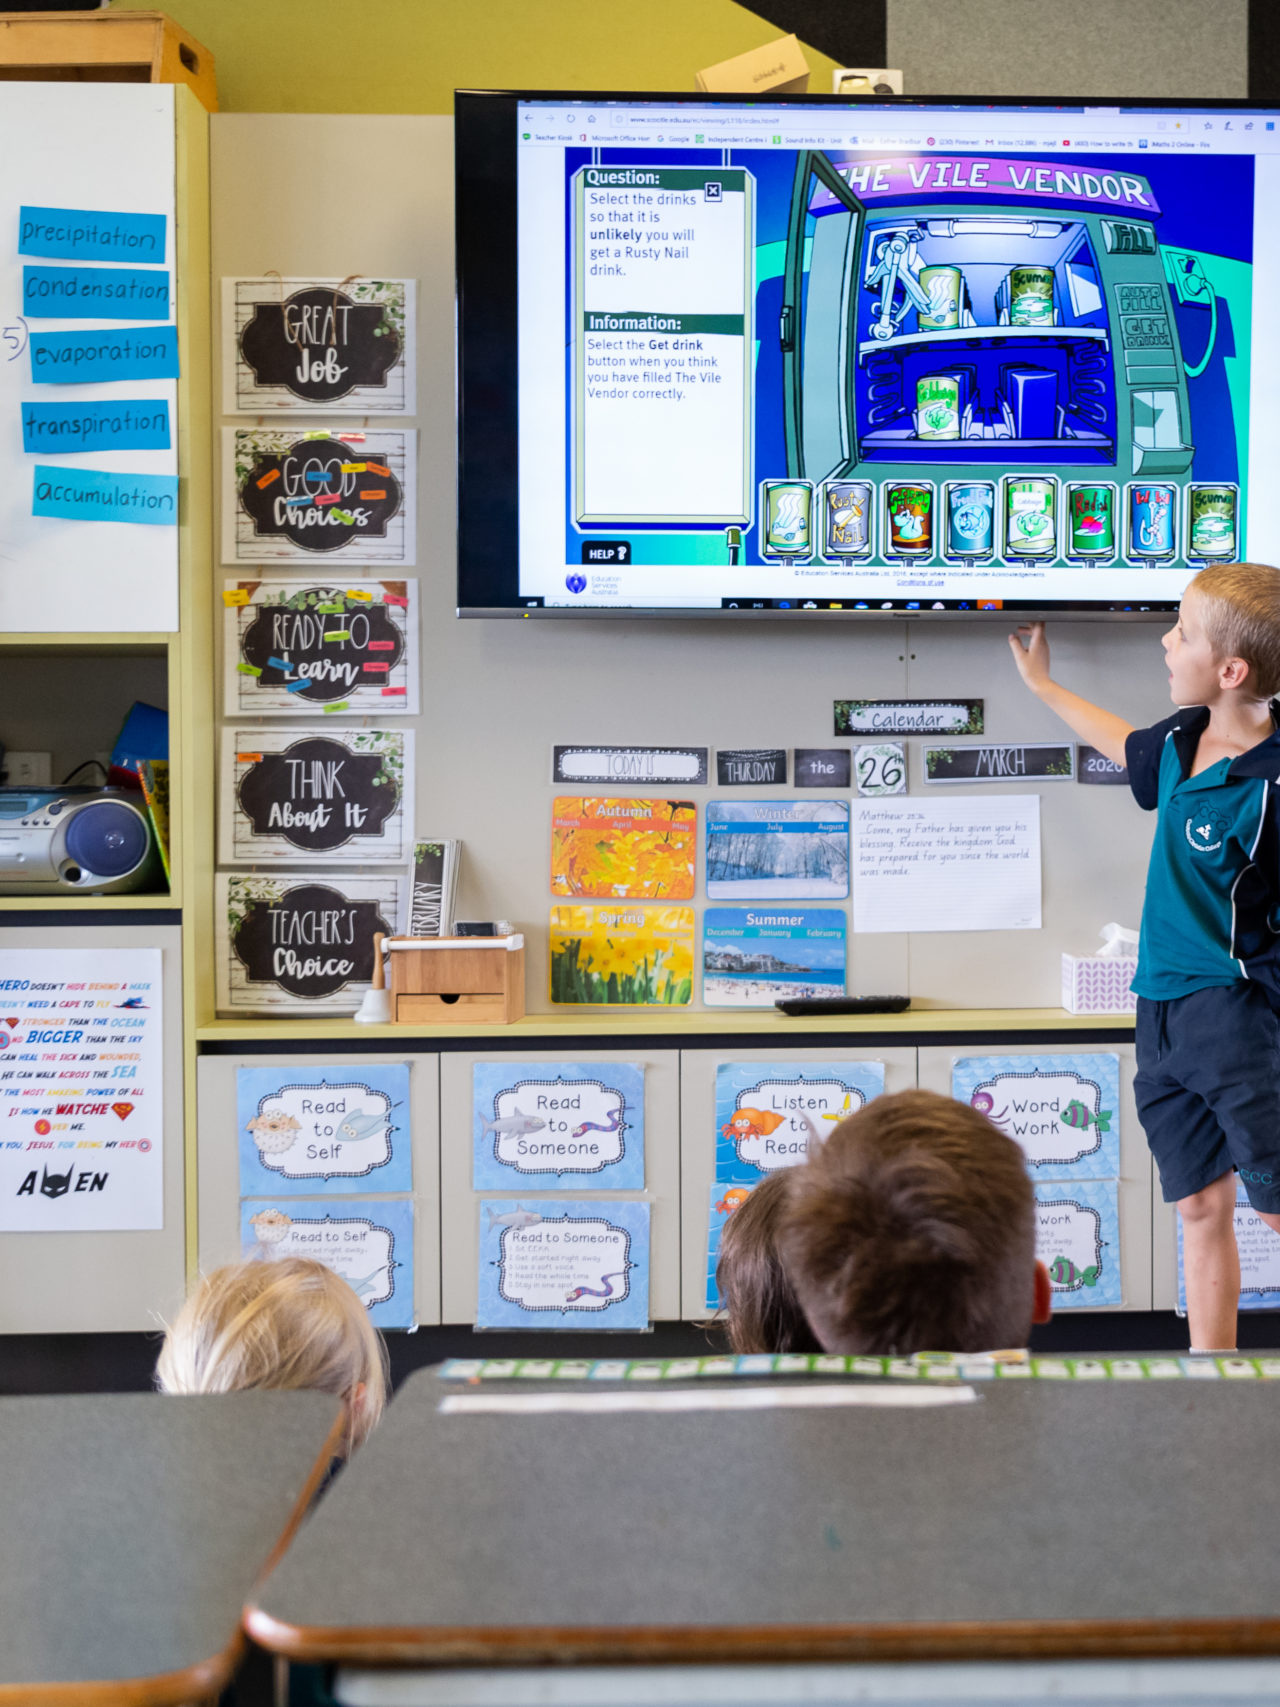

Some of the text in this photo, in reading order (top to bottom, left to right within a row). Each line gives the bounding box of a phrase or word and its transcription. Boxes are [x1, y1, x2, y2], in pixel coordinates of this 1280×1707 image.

[586, 170, 661, 187] Question:
[907, 163, 990, 189] VILE
[1008, 166, 1151, 208] VENDOR
[590, 192, 697, 207] Select the drinks
[590, 211, 661, 224] so that it is
[22, 221, 156, 250] precipitation
[590, 228, 695, 244] unlikely you will
[590, 246, 689, 262] get a Rusty Nail
[590, 264, 627, 277] drink.
[26, 276, 169, 303] Condensation
[284, 304, 353, 346] GREAT
[590, 315, 682, 331] Information:
[1124, 317, 1168, 336] GET
[35, 340, 166, 366] evaporation
[587, 339, 703, 351] Select the Get drink
[296, 347, 349, 384] Job
[587, 356, 718, 369] button when you think
[587, 372, 722, 385] you have filled The Vile
[587, 388, 686, 401] Vendor correctly.
[26, 413, 166, 442] transpiration
[283, 456, 357, 498] GOOD
[36, 481, 174, 511] accumulation
[829, 491, 865, 511] Rusty
[832, 527, 864, 544] Nail
[589, 549, 615, 560] HELP
[273, 614, 370, 651] READY TO
[284, 650, 360, 688] Learn
[871, 712, 945, 728] Calendar
[607, 754, 644, 776] TODAY
[810, 761, 836, 774] the
[976, 748, 1026, 776] MARCH
[1088, 759, 1124, 773] 2020
[285, 758, 347, 800] THINK
[725, 761, 777, 783] THURSDAY
[268, 802, 369, 833] About It
[596, 804, 652, 818] Autumn
[754, 807, 801, 819] Winter
[859, 810, 904, 821] Matthew
[710, 823, 728, 832] June
[766, 823, 783, 833] July
[818, 822, 845, 833] August
[600, 911, 645, 927] Spring
[746, 913, 804, 926] Summer
[267, 909, 357, 946] TEACHER'S
[707, 928, 745, 937] December
[759, 928, 791, 938] January
[807, 929, 842, 939] February
[273, 947, 355, 980] Choice
[26, 1030, 84, 1043] BIGGER
[111, 1065, 138, 1078] SEA
[55, 1103, 110, 1115] WATCHE
[302, 1099, 346, 1114] Read
[537, 1095, 581, 1110] Read
[771, 1094, 828, 1110] Listen
[1013, 1097, 1060, 1113] Word
[313, 1121, 334, 1137] to
[549, 1117, 568, 1133] to
[790, 1118, 808, 1133] to
[1013, 1120, 1060, 1136] Work
[306, 1143, 342, 1160] Self
[517, 1139, 600, 1156] Someone
[512, 1232, 619, 1243] Read to Someone
